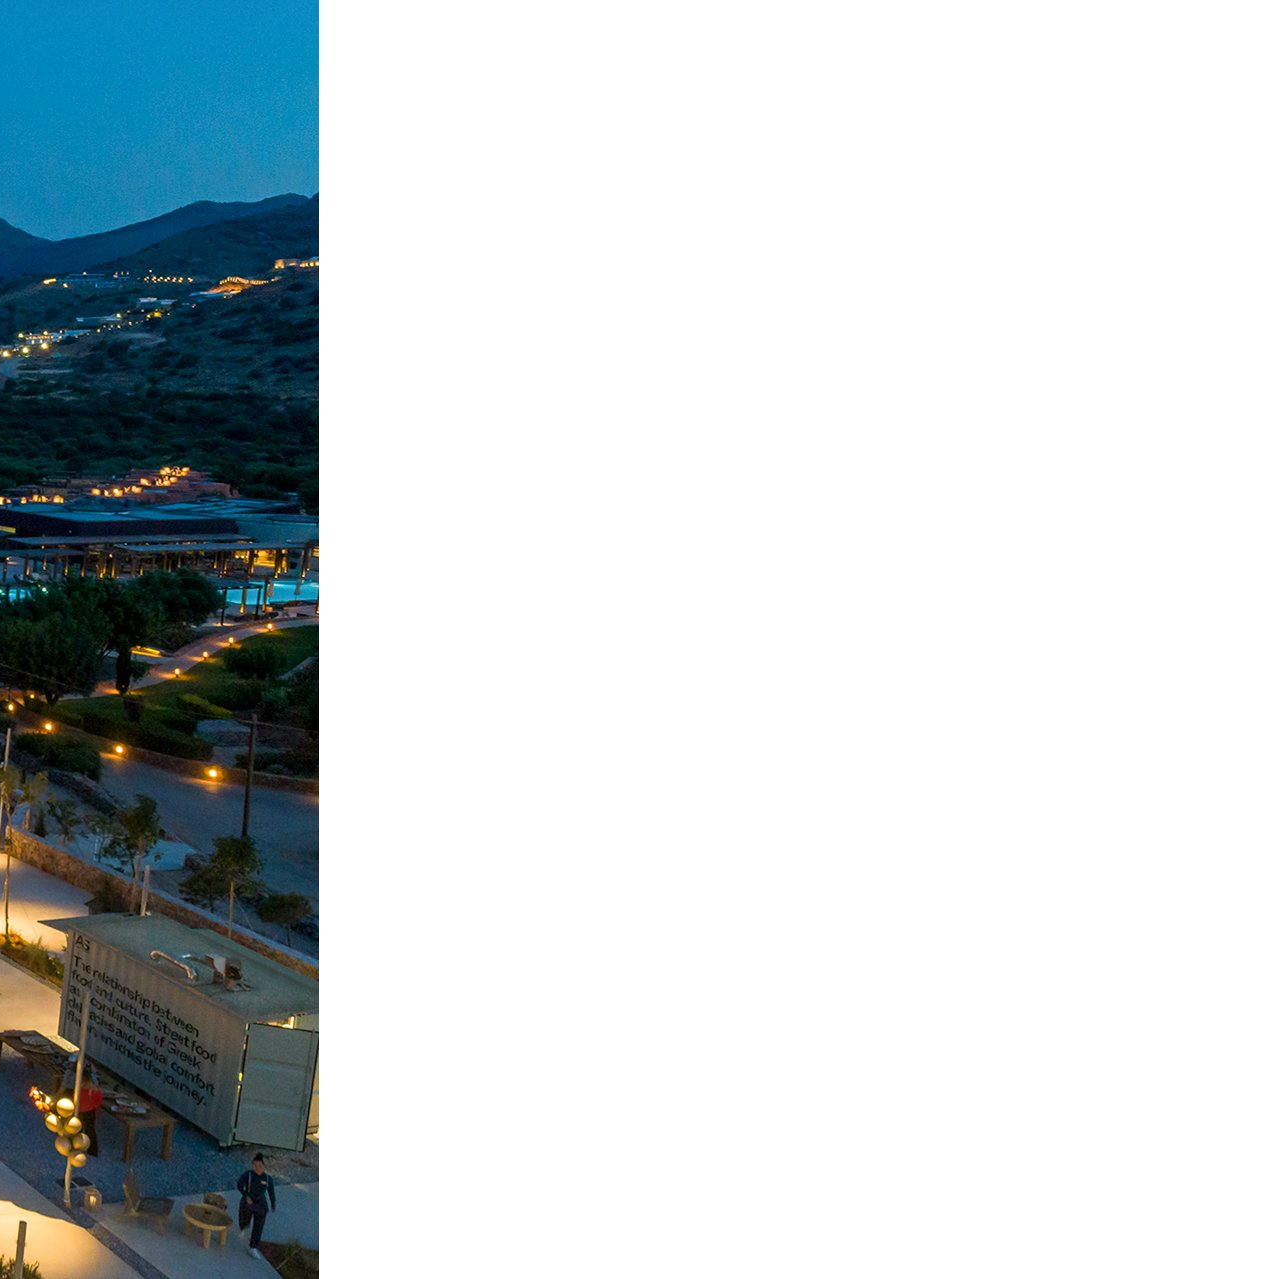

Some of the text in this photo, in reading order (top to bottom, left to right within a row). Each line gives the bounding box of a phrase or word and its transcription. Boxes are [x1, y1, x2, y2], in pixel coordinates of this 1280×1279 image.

[71, 969, 93, 990] food
[115, 998, 151, 1026] cuture.
[191, 1040, 217, 1064] food
[73, 954, 199, 1038] The relationship between
[90, 997, 151, 1041] combinaton
[153, 1035, 166, 1048] of
[167, 1041, 202, 1070] Greek
[115, 1027, 136, 1045] and
[135, 1040, 168, 1065] goba
[171, 1061, 216, 1097] comfort
